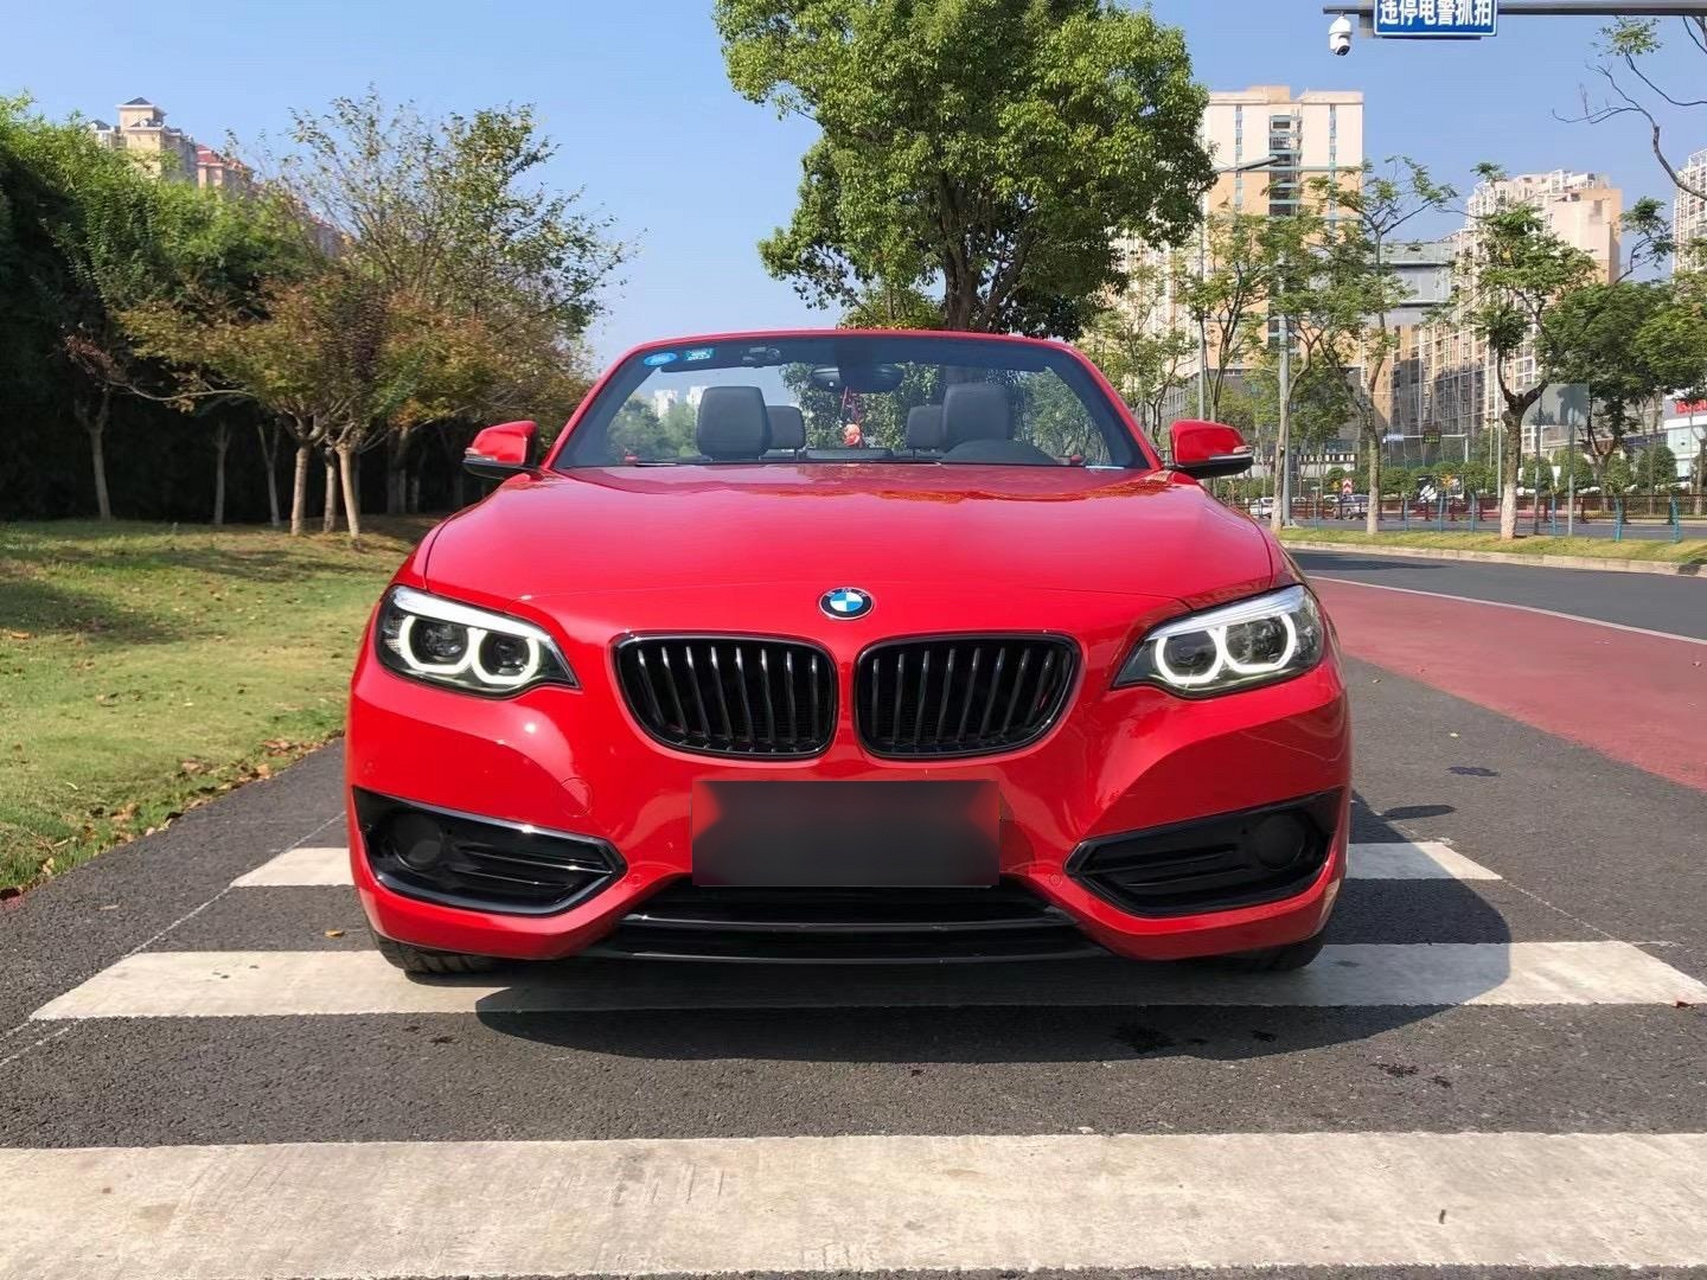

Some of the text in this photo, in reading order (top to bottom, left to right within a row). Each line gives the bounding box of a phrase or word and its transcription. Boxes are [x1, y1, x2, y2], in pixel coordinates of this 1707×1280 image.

[1380, 0, 1492, 26] 违停电警抓拍
